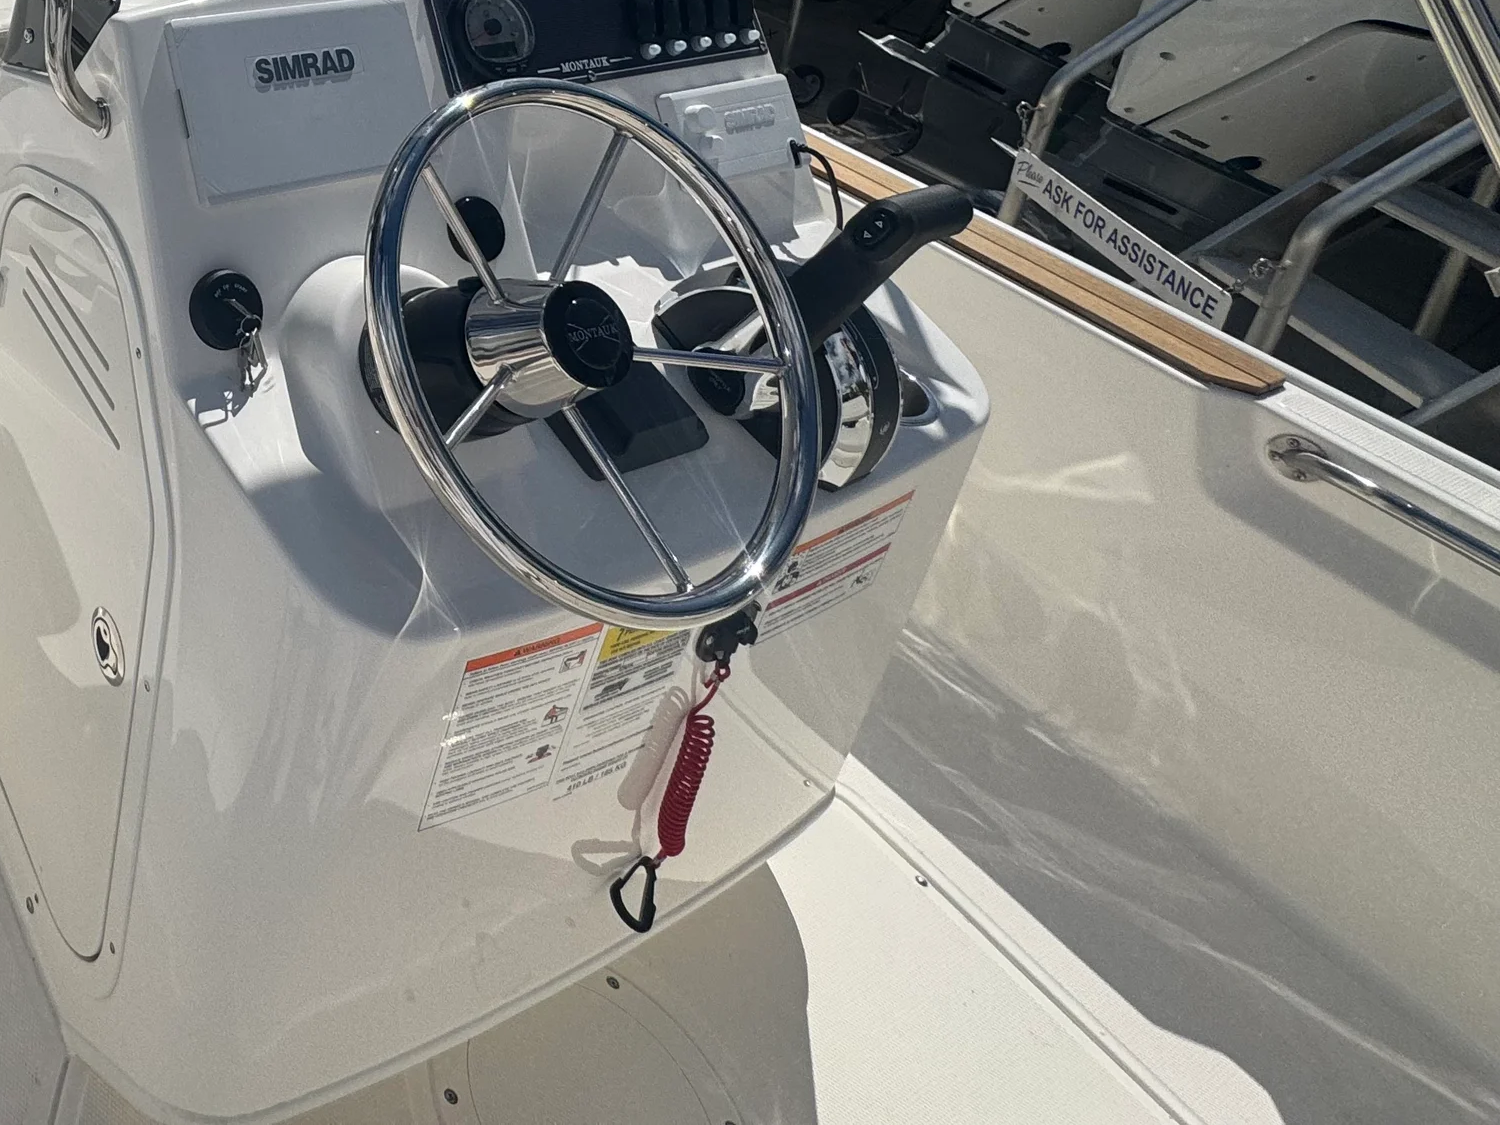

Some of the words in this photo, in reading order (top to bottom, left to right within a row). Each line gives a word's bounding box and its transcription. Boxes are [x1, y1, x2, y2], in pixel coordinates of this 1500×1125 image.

[255, 48, 355, 84] SIMRAD
[560, 56, 611, 73] MONTAUK
[1043, 179, 1075, 214] ASK
[1074, 201, 1107, 239] FOR
[1105, 228, 1219, 320] ASSISTANCE
